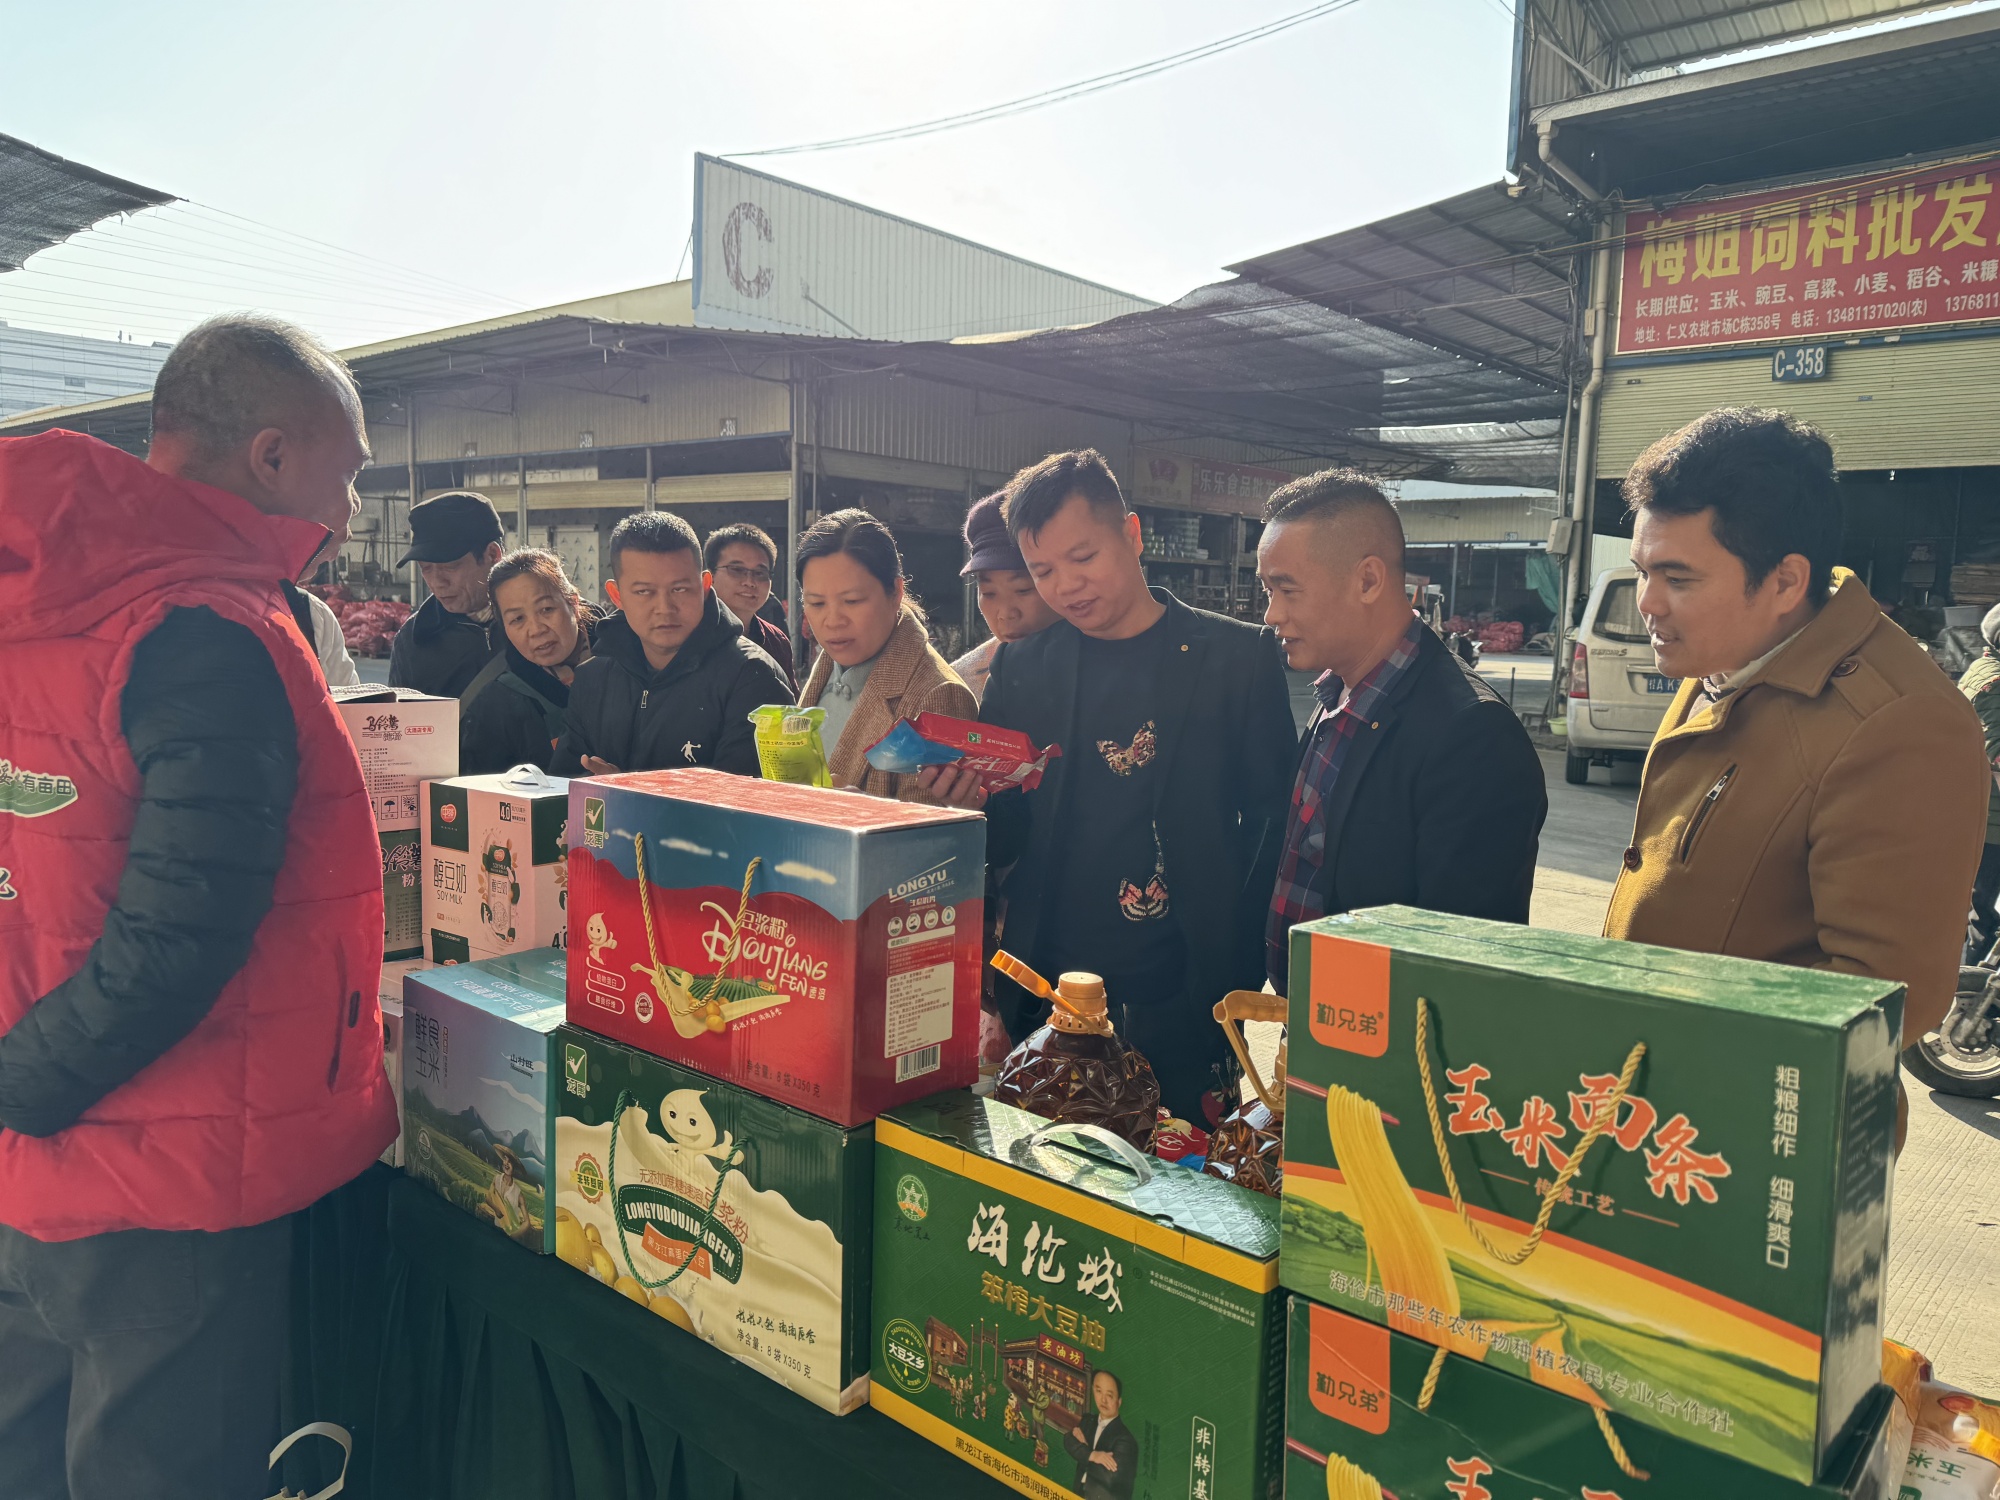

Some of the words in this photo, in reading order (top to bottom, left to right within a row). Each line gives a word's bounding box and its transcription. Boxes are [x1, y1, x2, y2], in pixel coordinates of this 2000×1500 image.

[1640, 173, 2000, 288] 梅姐饲料批发
[1945, 291, 2000, 312] 1376811
[1774, 346, 1825, 378] C-358
[1200, 469, 1287, 498] 乐乐食品批发
[402, 872, 421, 888] 粉
[434, 858, 467, 894] 醇豆奶
[888, 869, 947, 899] LONGYU
[437, 889, 449, 902] SOY
[449, 893, 463, 906] MILK
[779, 972, 807, 997] FEN
[1316, 1002, 1378, 1036] 勤兄弟
[1772, 1065, 1800, 1158] 粗粮细作
[1443, 1063, 1732, 1205] 玉米面条
[1766, 1175, 1794, 1270] 细滑爽口
[647, 1235, 705, 1268] 黑龙江高蛋白豆
[980, 1270, 1106, 1352] 笨榨大豆油
[767, 1345, 772, 1357] 8
[773, 1348, 781, 1363] 袋
[783, 1354, 801, 1372] X350
[803, 1364, 811, 1379] 克
[888, 1342, 925, 1370] 大豆之乡
[1042, 1338, 1081, 1365] 老油坊
[1329, 1269, 1734, 1438] 海伦市那些年农作物种植农民专业合作社
[1315, 1371, 1378, 1414] 勤兄弟
